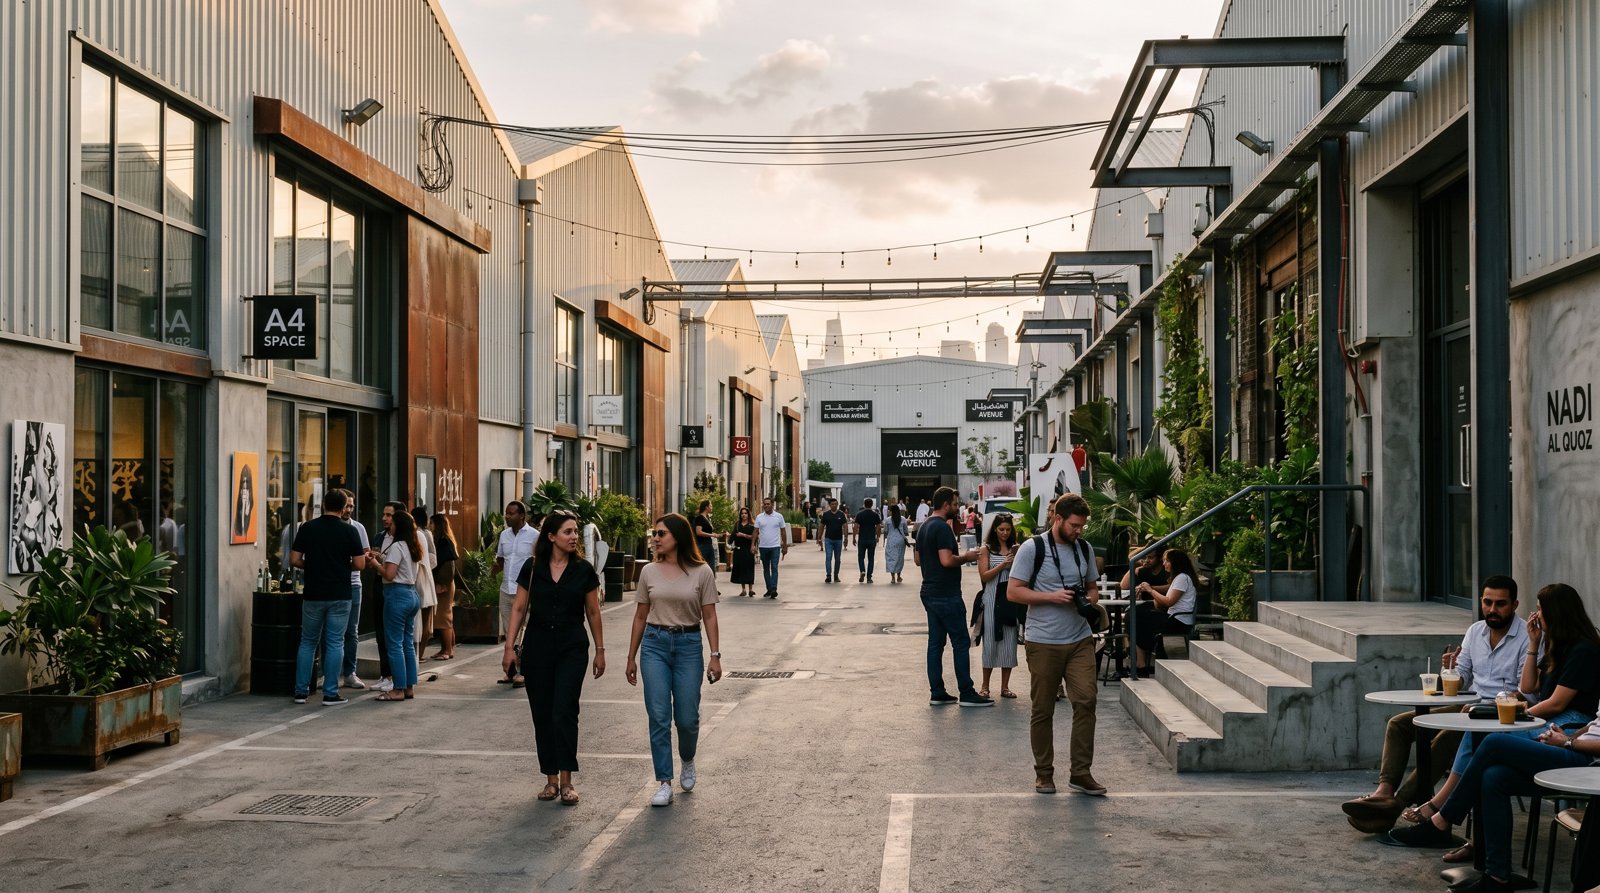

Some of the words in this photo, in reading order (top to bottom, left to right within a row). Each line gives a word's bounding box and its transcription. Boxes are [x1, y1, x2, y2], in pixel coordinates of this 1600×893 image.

[264, 308, 306, 332] A4
[264, 335, 306, 347] SPACE
[1547, 383, 1592, 426] NADI
[1548, 434, 1561, 453] AL
[1563, 429, 1593, 452] QUOZ
[900, 459, 937, 467] AVENUE
